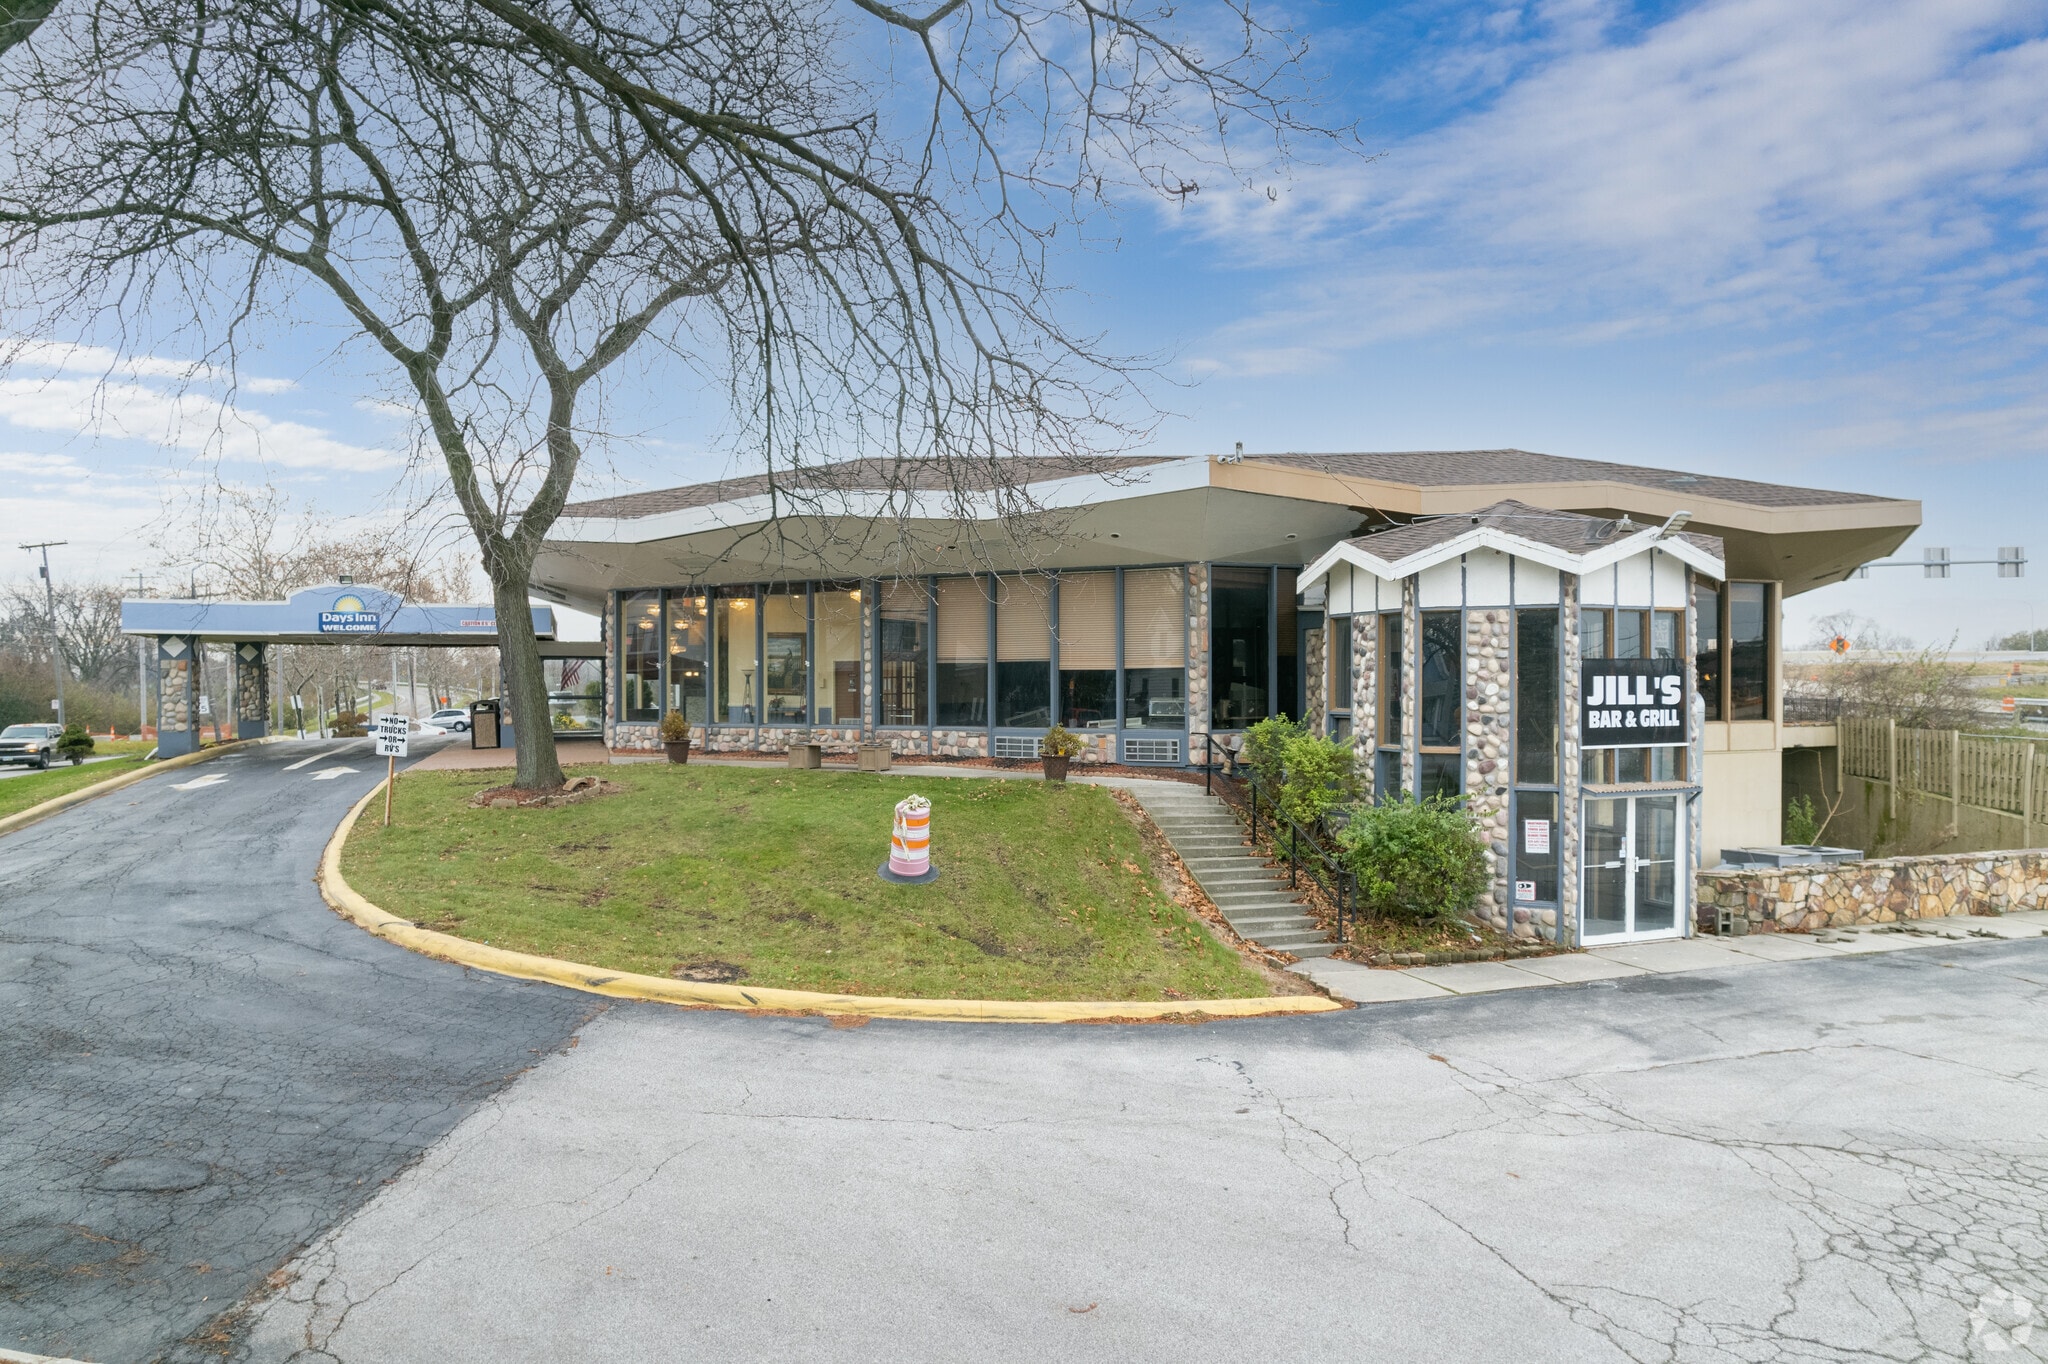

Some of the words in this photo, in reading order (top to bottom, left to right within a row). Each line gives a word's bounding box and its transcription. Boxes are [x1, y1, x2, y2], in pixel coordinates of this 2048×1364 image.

[322, 613, 354, 623] Days
[355, 613, 377, 622] Inn
[1586, 675, 1682, 706] JILL'S
[389, 717, 399, 725] NO
[1588, 710, 1622, 728] BAR
[1625, 710, 1638, 728] &
[1640, 708, 1680, 727] GRILL
[380, 725, 407, 735] TRUCKS
[388, 735, 397, 743] OR
